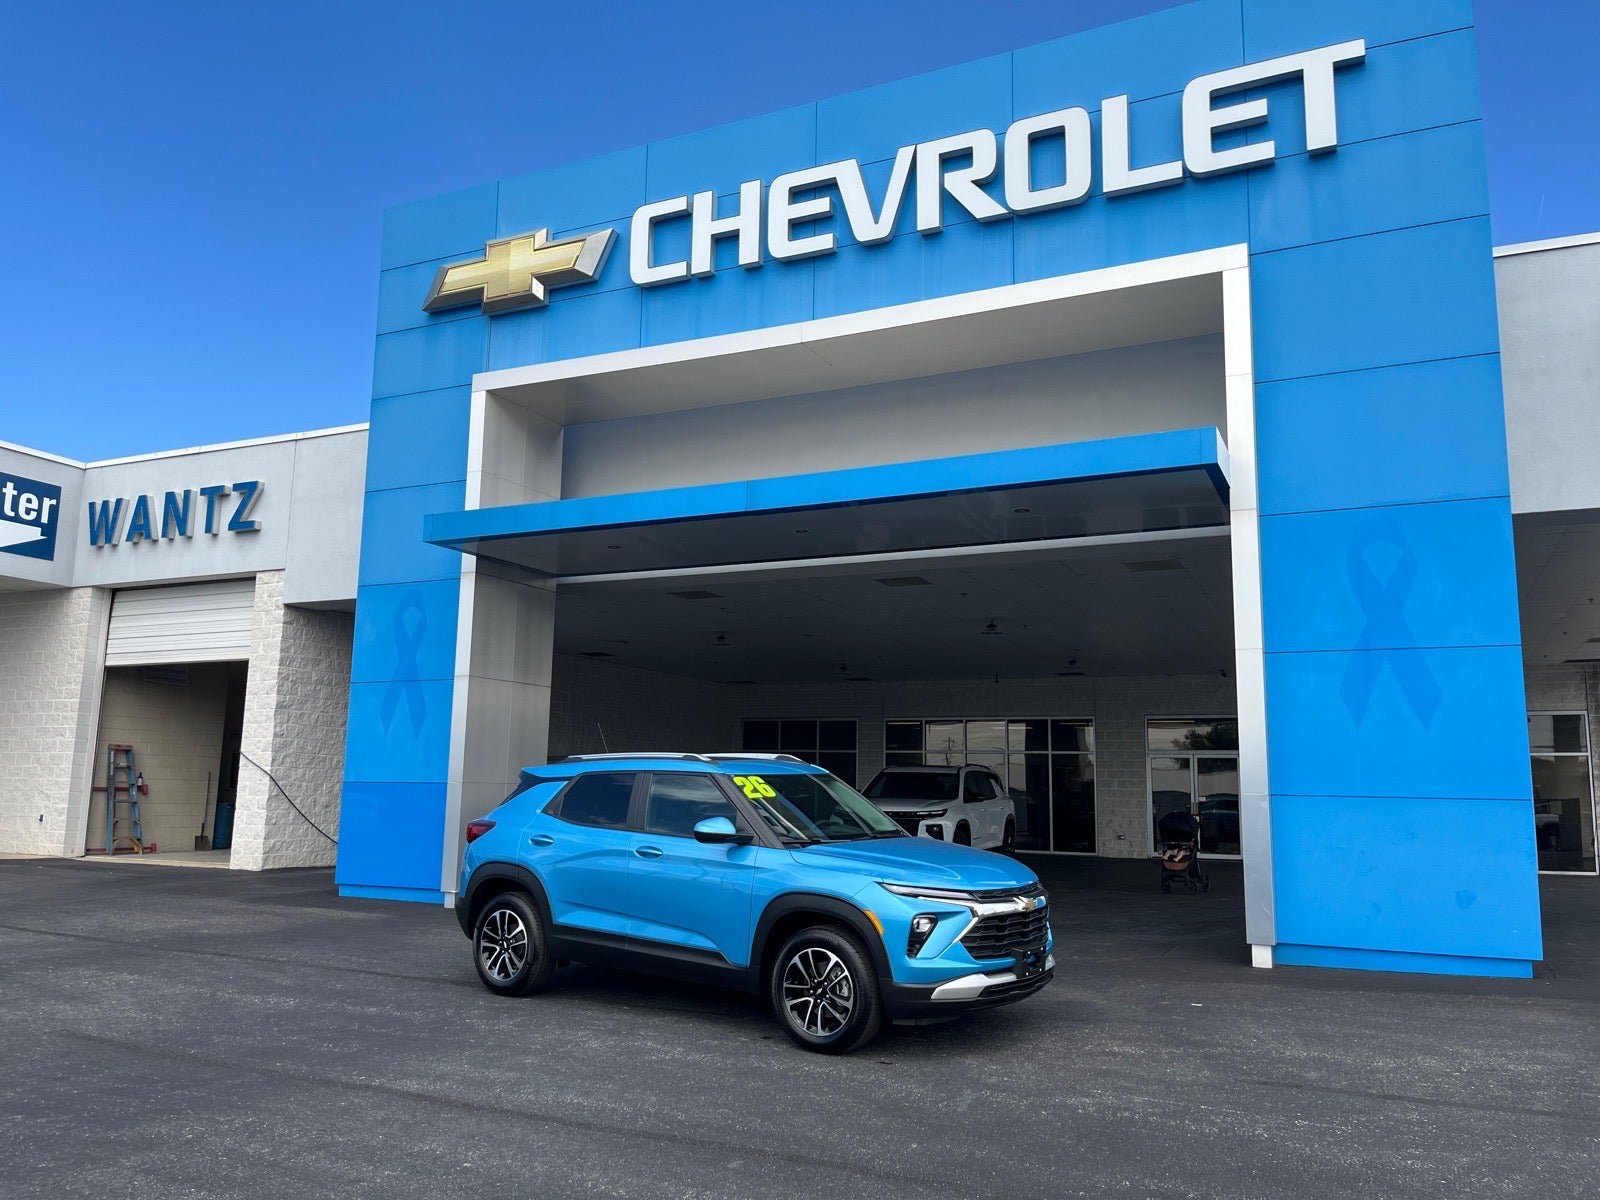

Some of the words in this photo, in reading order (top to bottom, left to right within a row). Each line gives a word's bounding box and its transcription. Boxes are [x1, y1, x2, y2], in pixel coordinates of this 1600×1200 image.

[629, 38, 1366, 288] CHEVROLET
[2, 481, 57, 524] ter
[88, 480, 264, 547] WANTZ
[733, 775, 777, 799] 26
